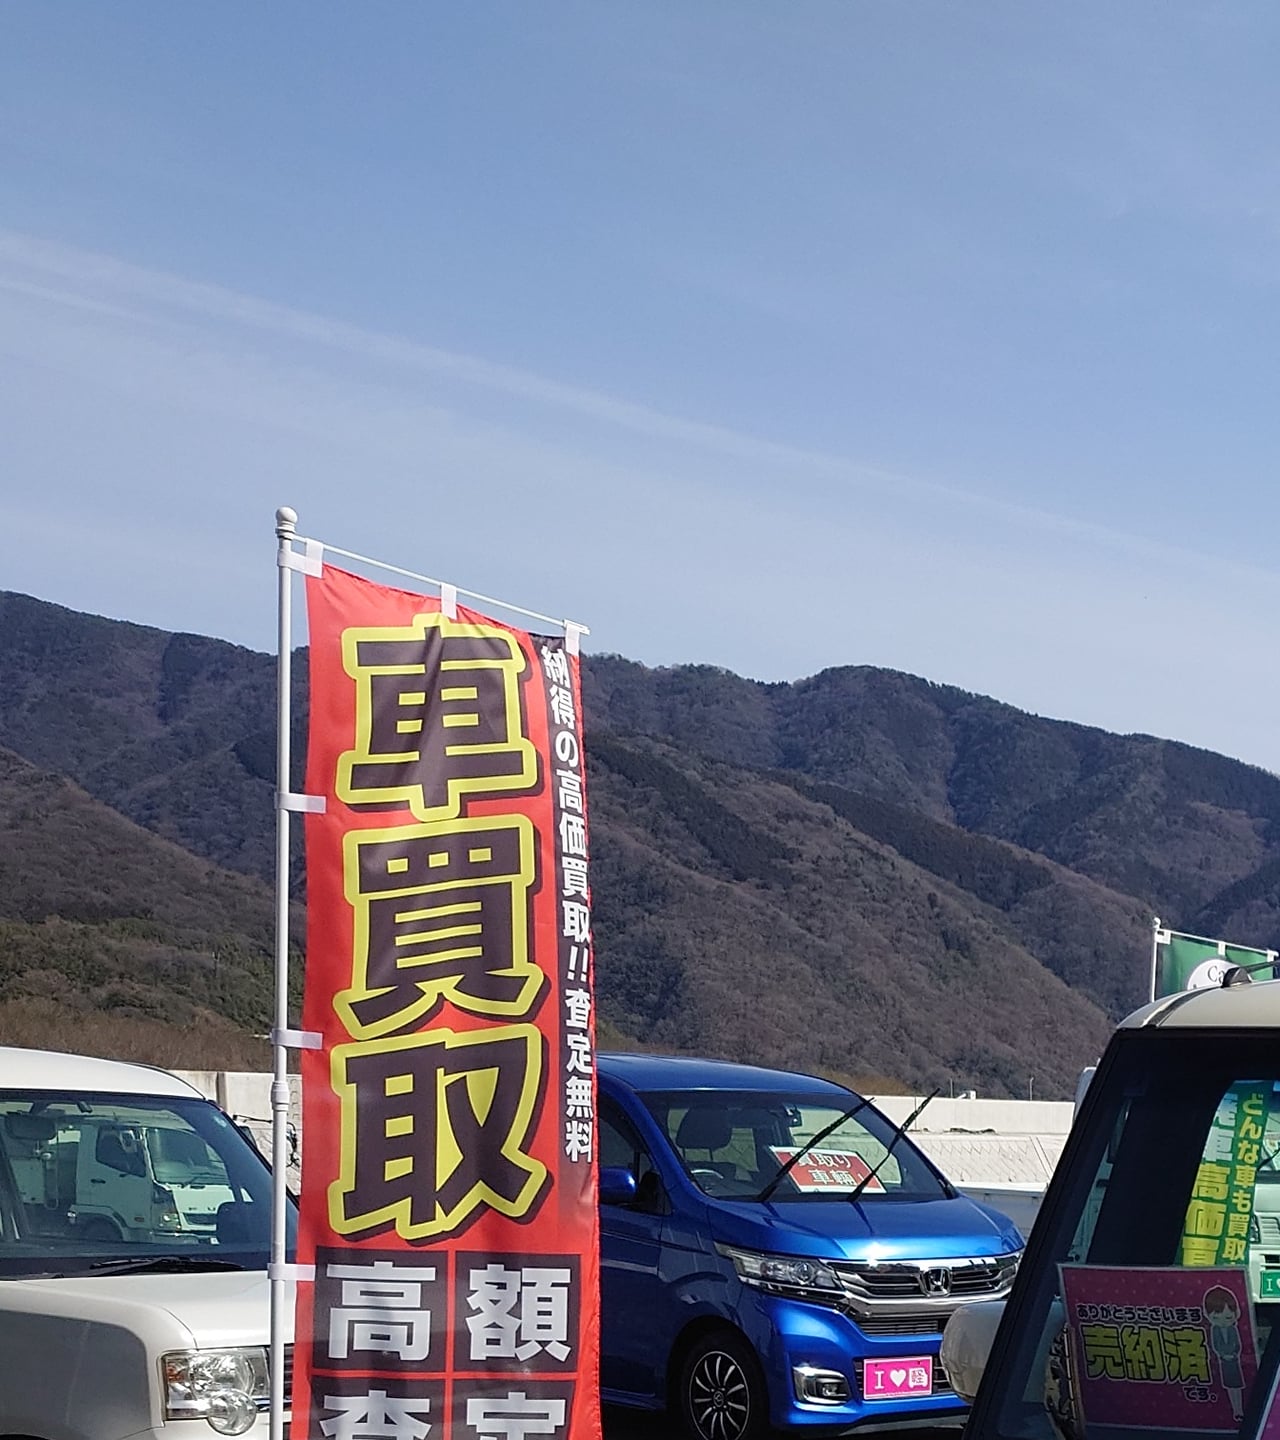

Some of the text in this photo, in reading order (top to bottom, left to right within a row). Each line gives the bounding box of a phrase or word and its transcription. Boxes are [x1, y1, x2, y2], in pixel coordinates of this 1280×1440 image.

[329, 612, 547, 1240] 車買取
[1222, 1093, 1264, 1265] どんな車も買取
[326, 1263, 573, 1364] 高額
[1075, 1303, 1203, 1323] ありがとうございます
[1080, 1323, 1213, 1385] 売約済
